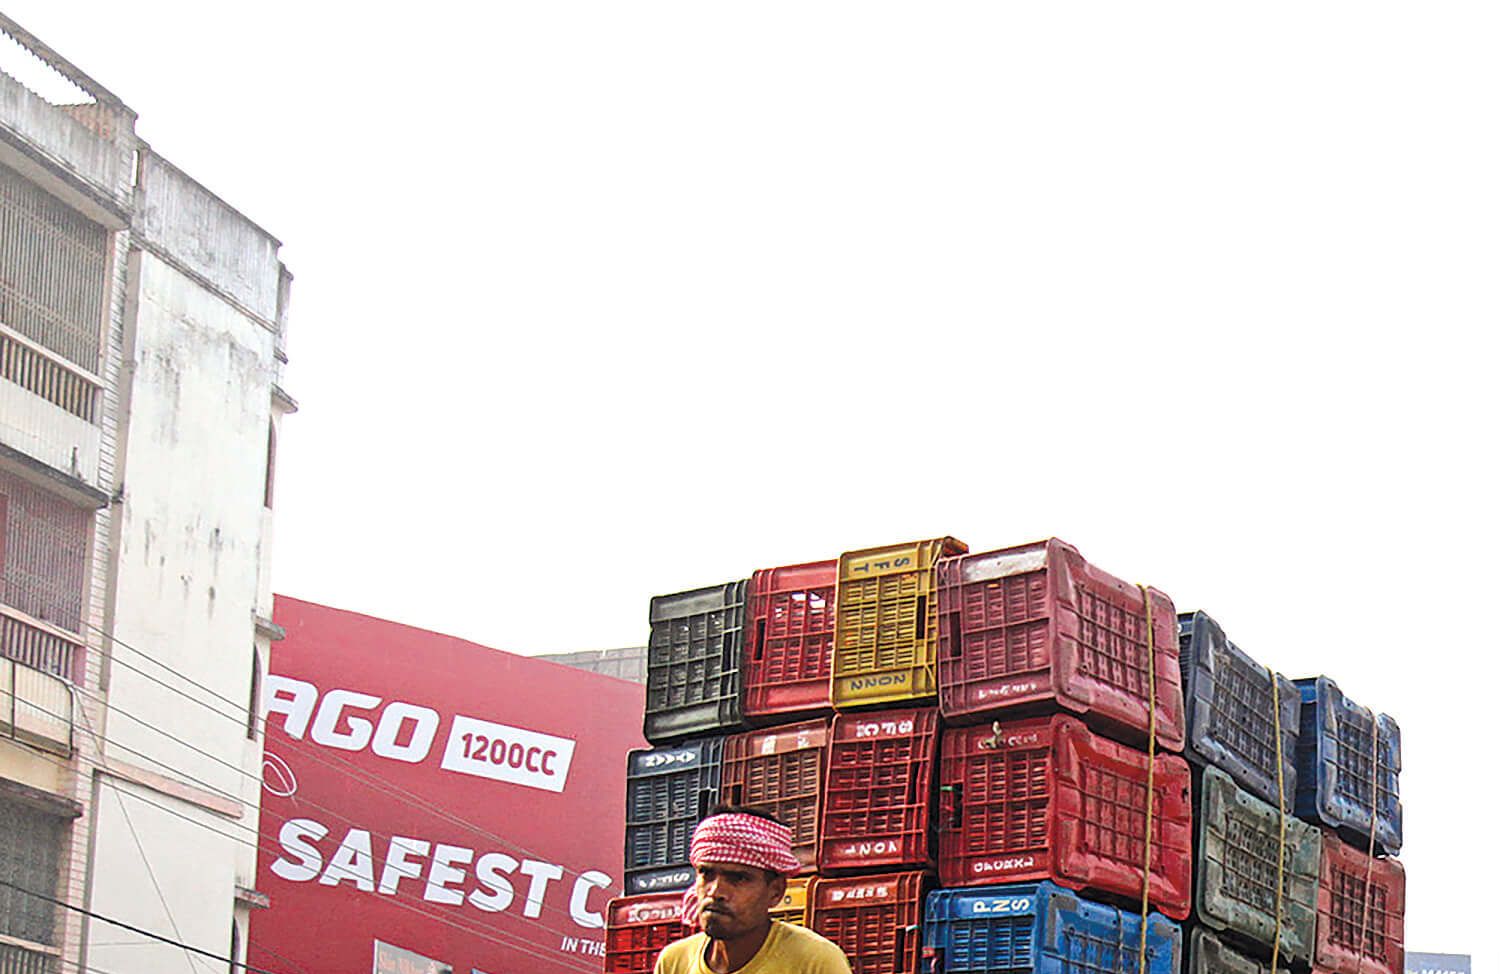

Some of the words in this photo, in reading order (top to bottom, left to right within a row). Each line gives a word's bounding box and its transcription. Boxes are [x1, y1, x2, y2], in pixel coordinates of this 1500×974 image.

[461, 733, 557, 776] 1200CC
[270, 818, 564, 919] SAFEST
[561, 936, 579, 953] IN
